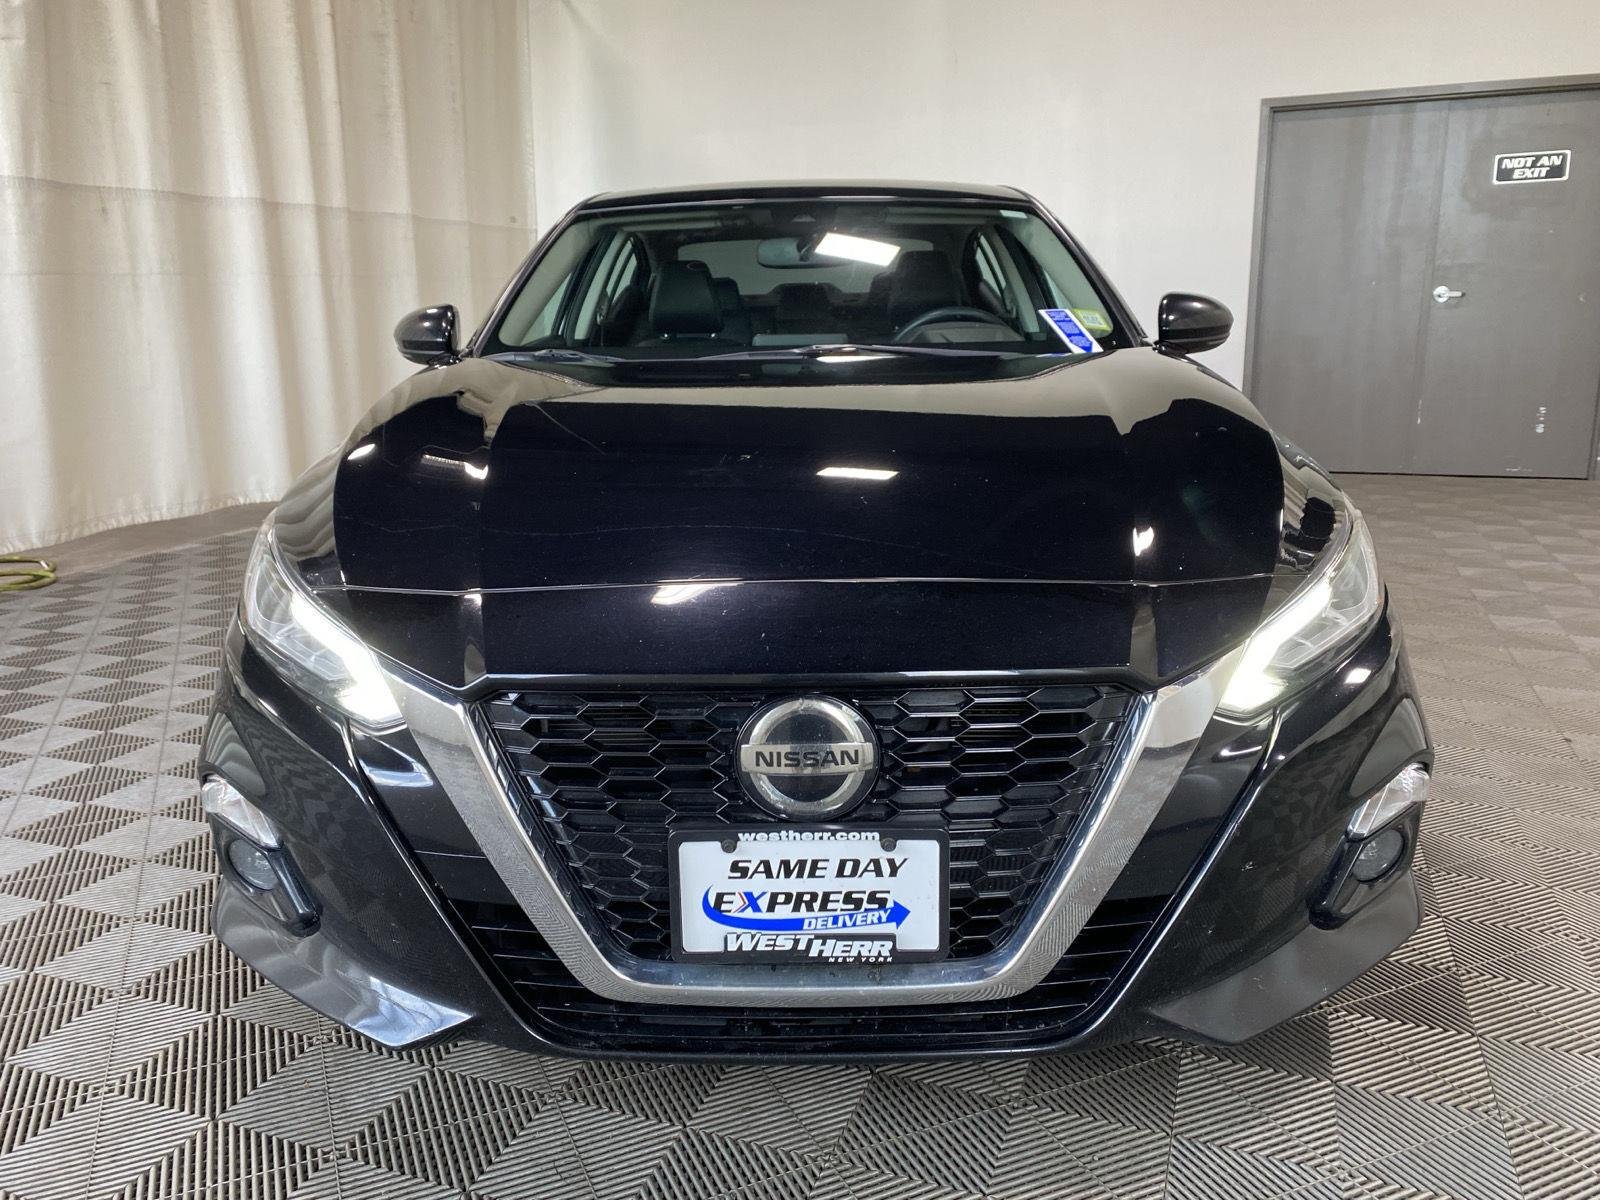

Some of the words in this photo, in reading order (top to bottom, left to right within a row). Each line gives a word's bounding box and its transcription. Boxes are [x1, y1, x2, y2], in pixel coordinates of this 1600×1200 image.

[1502, 157, 1535, 168] NOT
[1537, 155, 1562, 166] AN
[1513, 167, 1550, 179] EXIT
[755, 749, 859, 767] NISSAN
[737, 830, 880, 842] westherr.com
[728, 858, 829, 880] SAME
[835, 857, 909, 879] DAY
[712, 890, 891, 913] EXPRESS
[802, 909, 892, 930] DELIVERY
